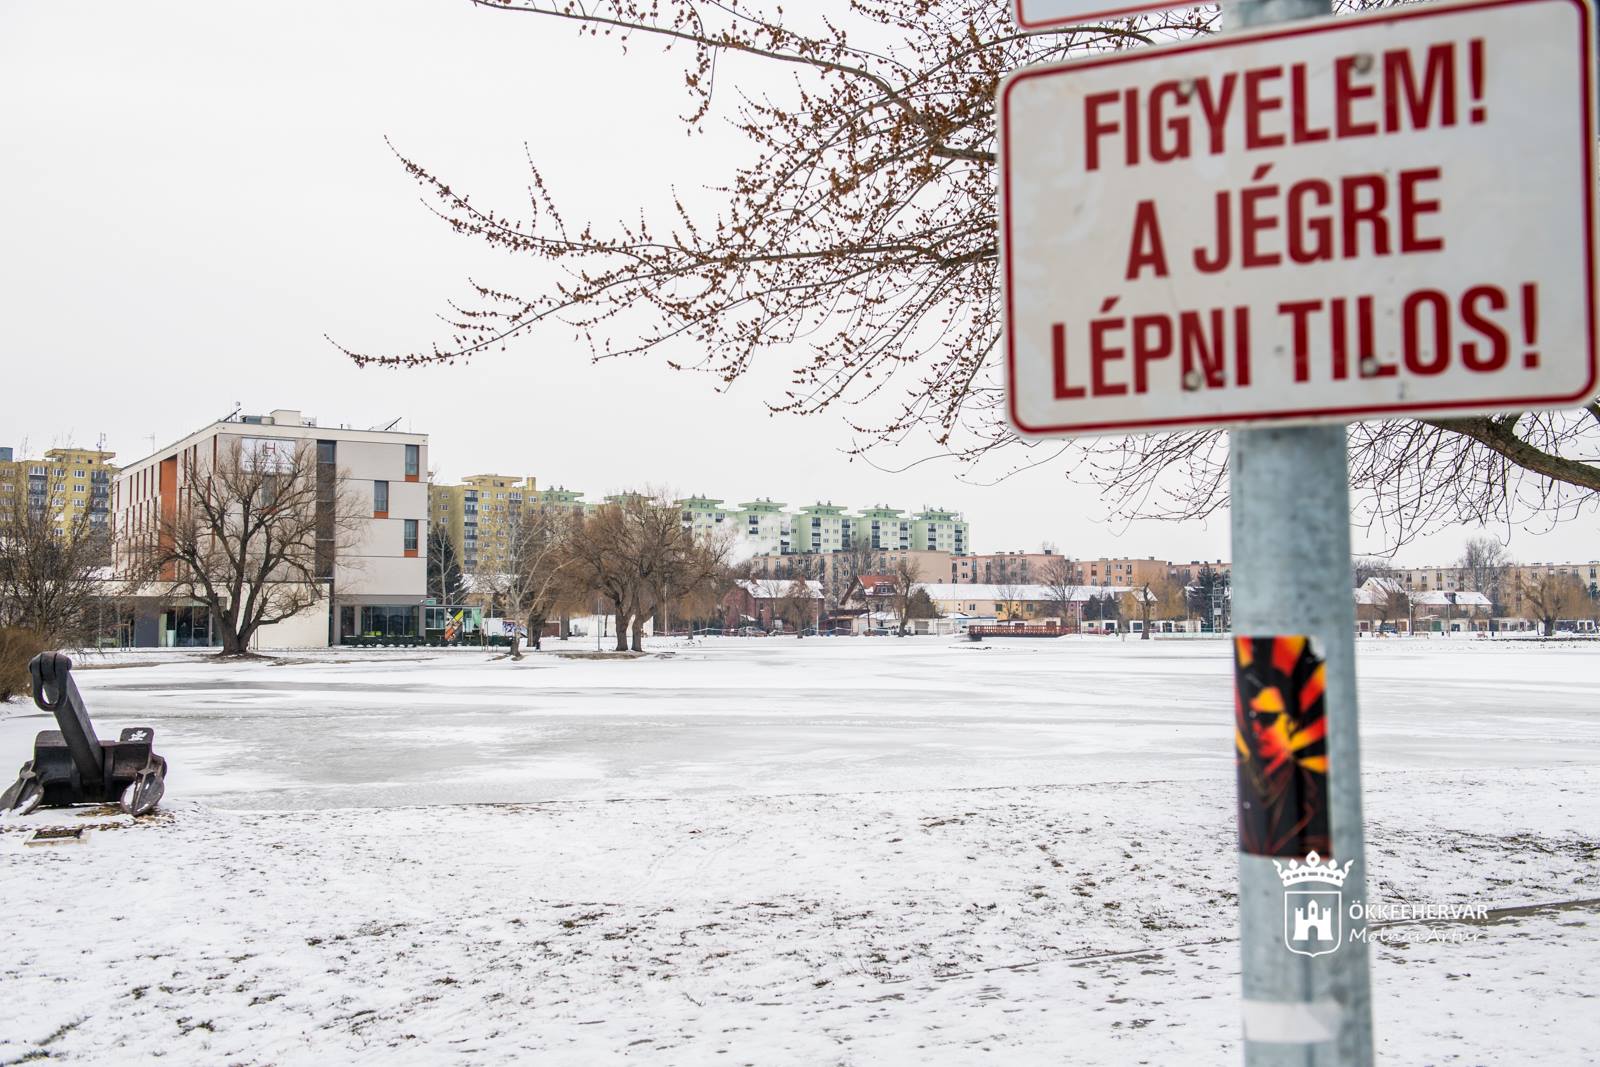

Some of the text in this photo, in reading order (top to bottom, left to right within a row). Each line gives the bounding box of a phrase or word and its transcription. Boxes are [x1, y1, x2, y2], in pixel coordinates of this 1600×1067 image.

[1083, 38, 1486, 171] FIGYELEM!
[1125, 164, 1444, 281] A JÉGRE
[1051, 283, 1541, 401] LÉPNI TILOS!
